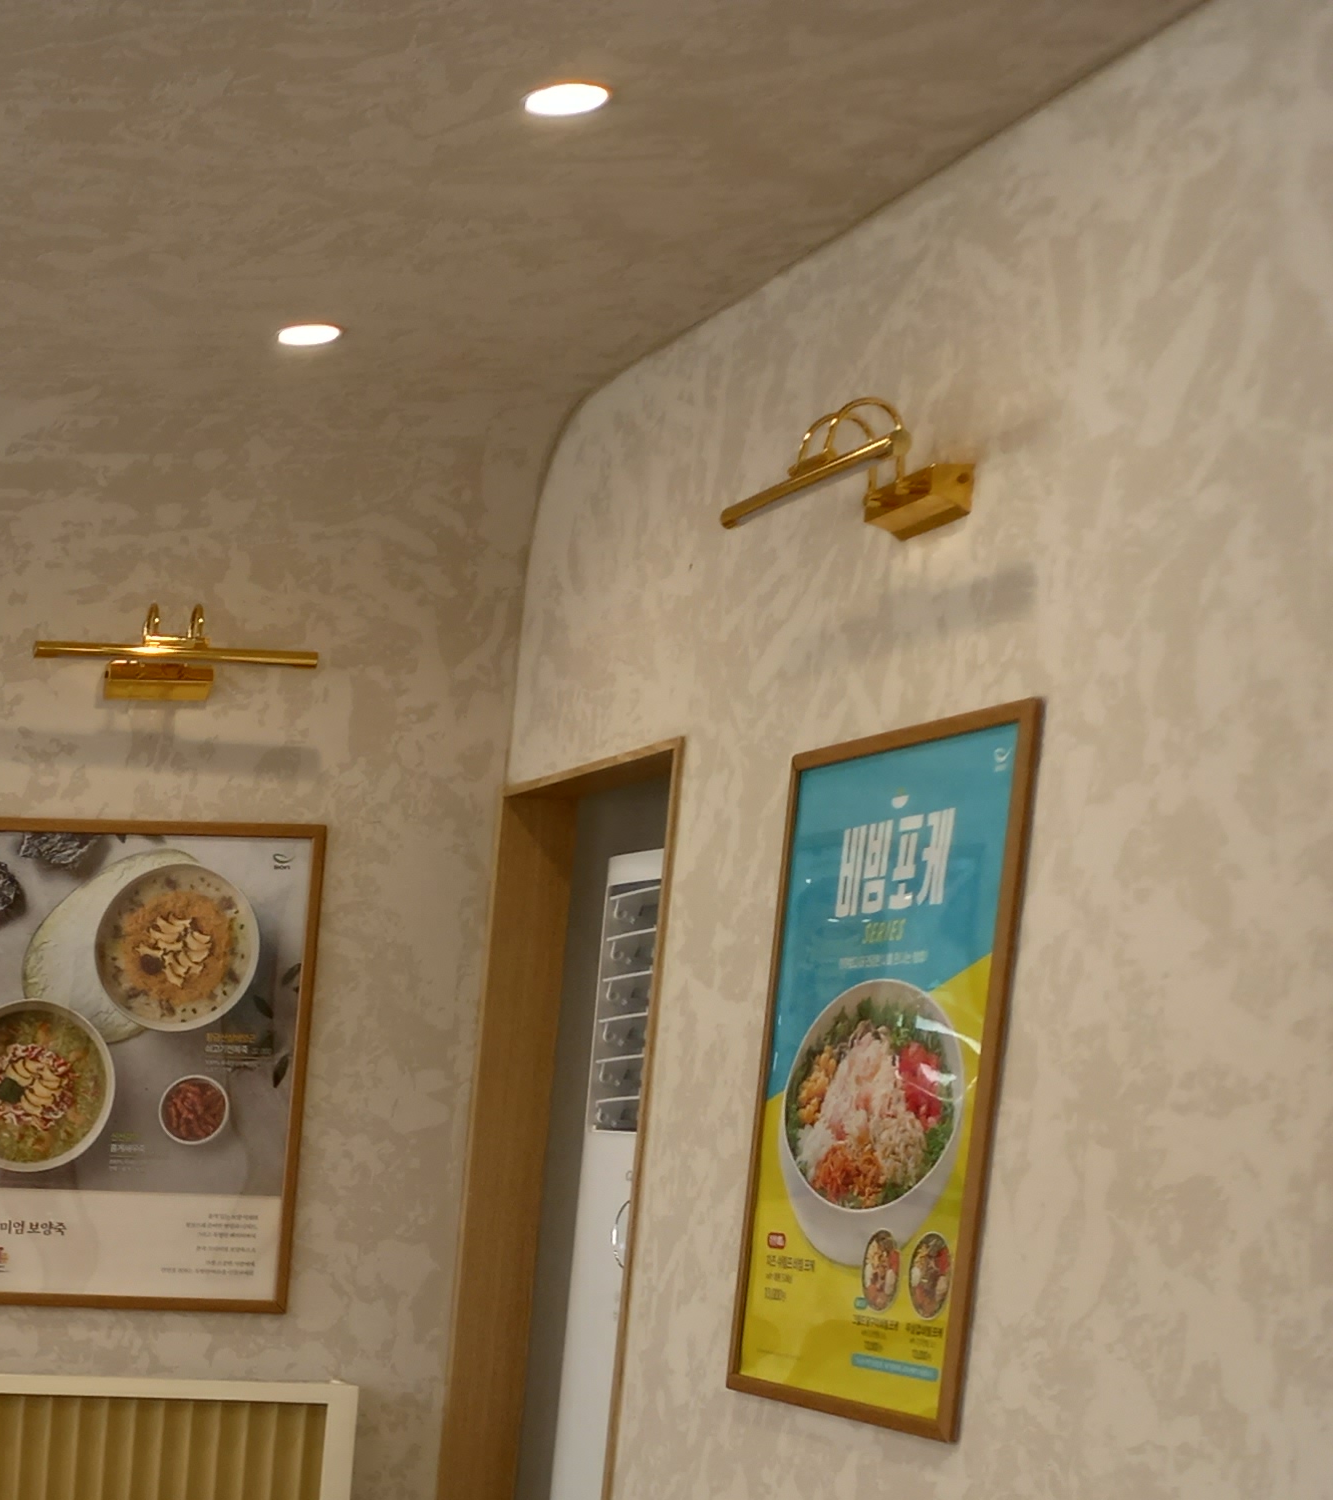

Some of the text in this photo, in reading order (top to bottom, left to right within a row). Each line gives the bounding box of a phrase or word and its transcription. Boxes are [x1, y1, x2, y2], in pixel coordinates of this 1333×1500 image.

[835, 807, 957, 918] 비빔포케
[862, 918, 907, 944] SERIES
[26, 1220, 68, 1236] 보양죽
